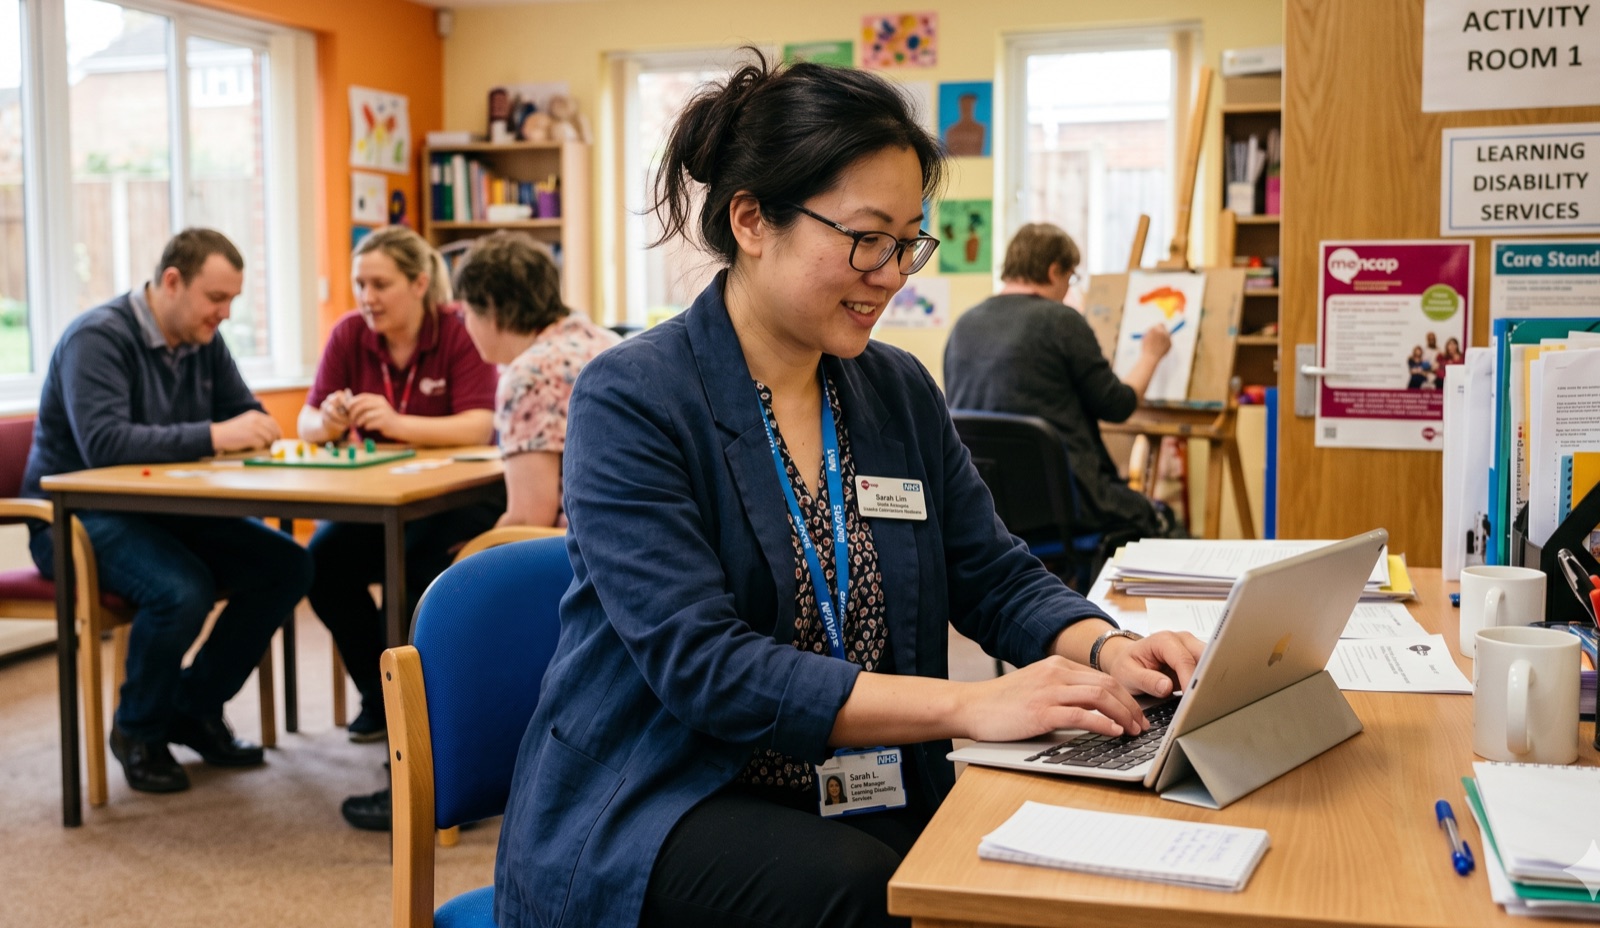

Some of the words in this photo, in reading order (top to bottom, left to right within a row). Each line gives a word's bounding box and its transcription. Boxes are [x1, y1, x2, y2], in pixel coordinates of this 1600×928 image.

[1463, 4, 1590, 32] ACTIVITY
[1468, 46, 1557, 71] ROOM
[1569, 45, 1583, 66] 1
[1477, 142, 1585, 162] LEARNING
[1473, 172, 1589, 192] DISABILITY
[1481, 202, 1580, 221] SERVICES
[1331, 257, 1399, 275] mencap
[1502, 251, 1543, 267] Care
[904, 483, 920, 491] NHS
[876, 494, 894, 502] Sarah
[878, 754, 897, 764] NHS
[849, 772, 871, 781] Sarah
[872, 771, 879, 779] L.
[851, 788, 873, 796] Learning
[874, 785, 897, 793] Disability
